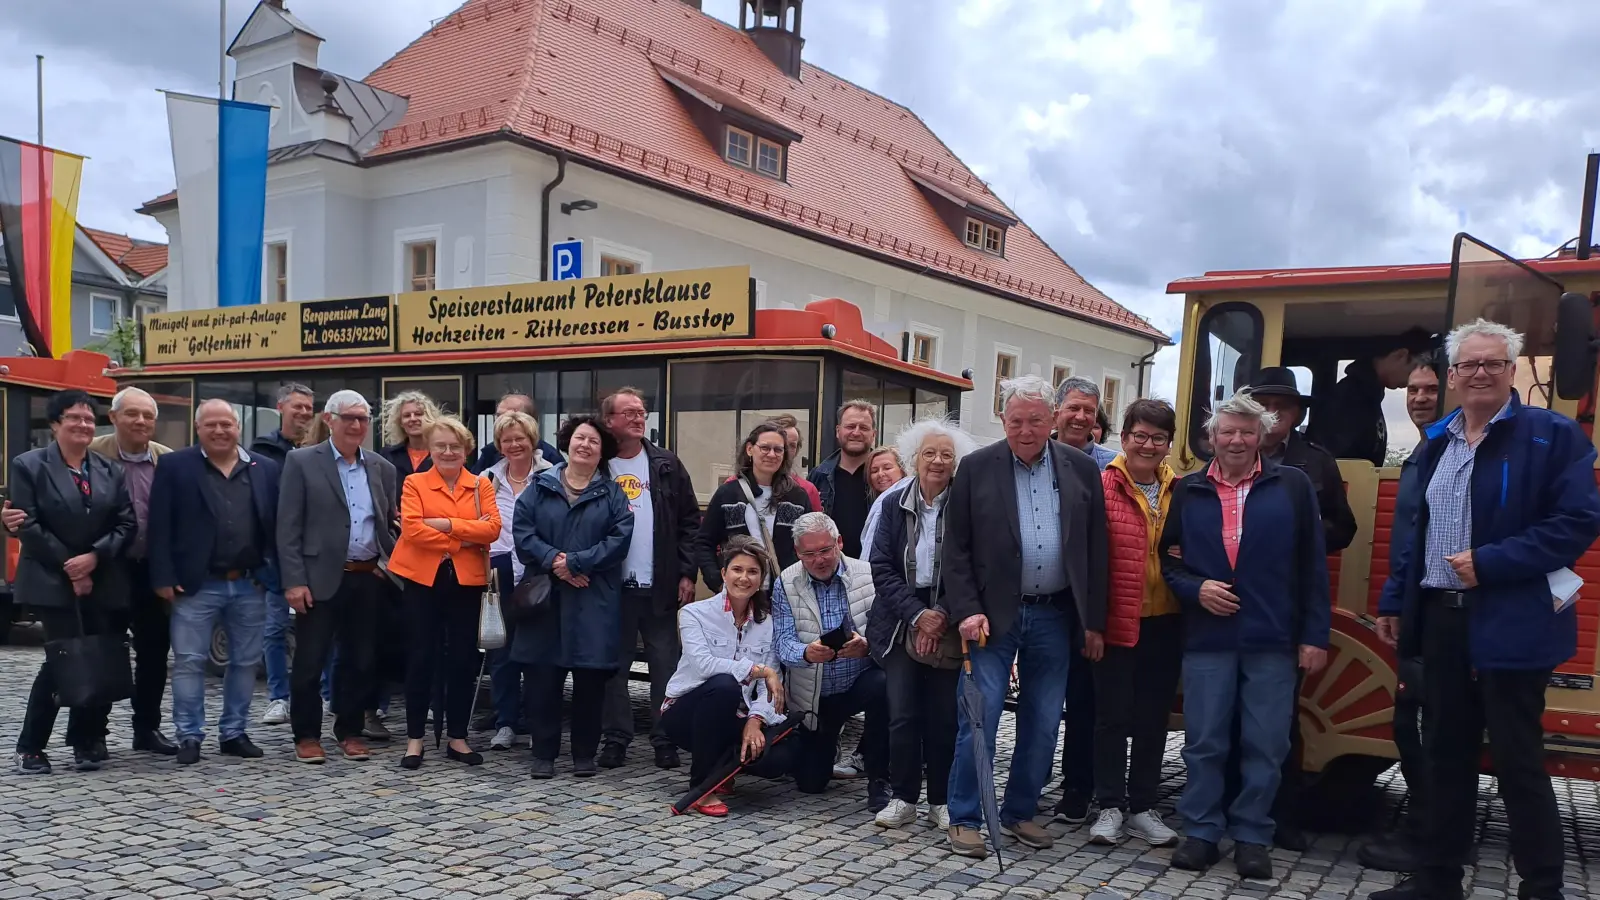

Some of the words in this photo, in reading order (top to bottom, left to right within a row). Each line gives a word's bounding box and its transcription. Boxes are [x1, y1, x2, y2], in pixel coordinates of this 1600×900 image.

[557, 249, 573, 280] P
[428, 285, 576, 324] Speiserestaurant
[583, 278, 712, 308] Petersklause
[149, 316, 189, 333] Minigolf
[191, 314, 210, 328] und
[212, 309, 287, 330] pit-pat-Anlage
[303, 305, 359, 326] Bergpension
[361, 303, 388, 321] Lang
[412, 325, 505, 345] Hochzeiten
[525, 319, 629, 339] Ritteressen
[652, 308, 735, 331] Busstop
[321, 325, 388, 343] 09633/92290
[157, 338, 177, 355] mit
